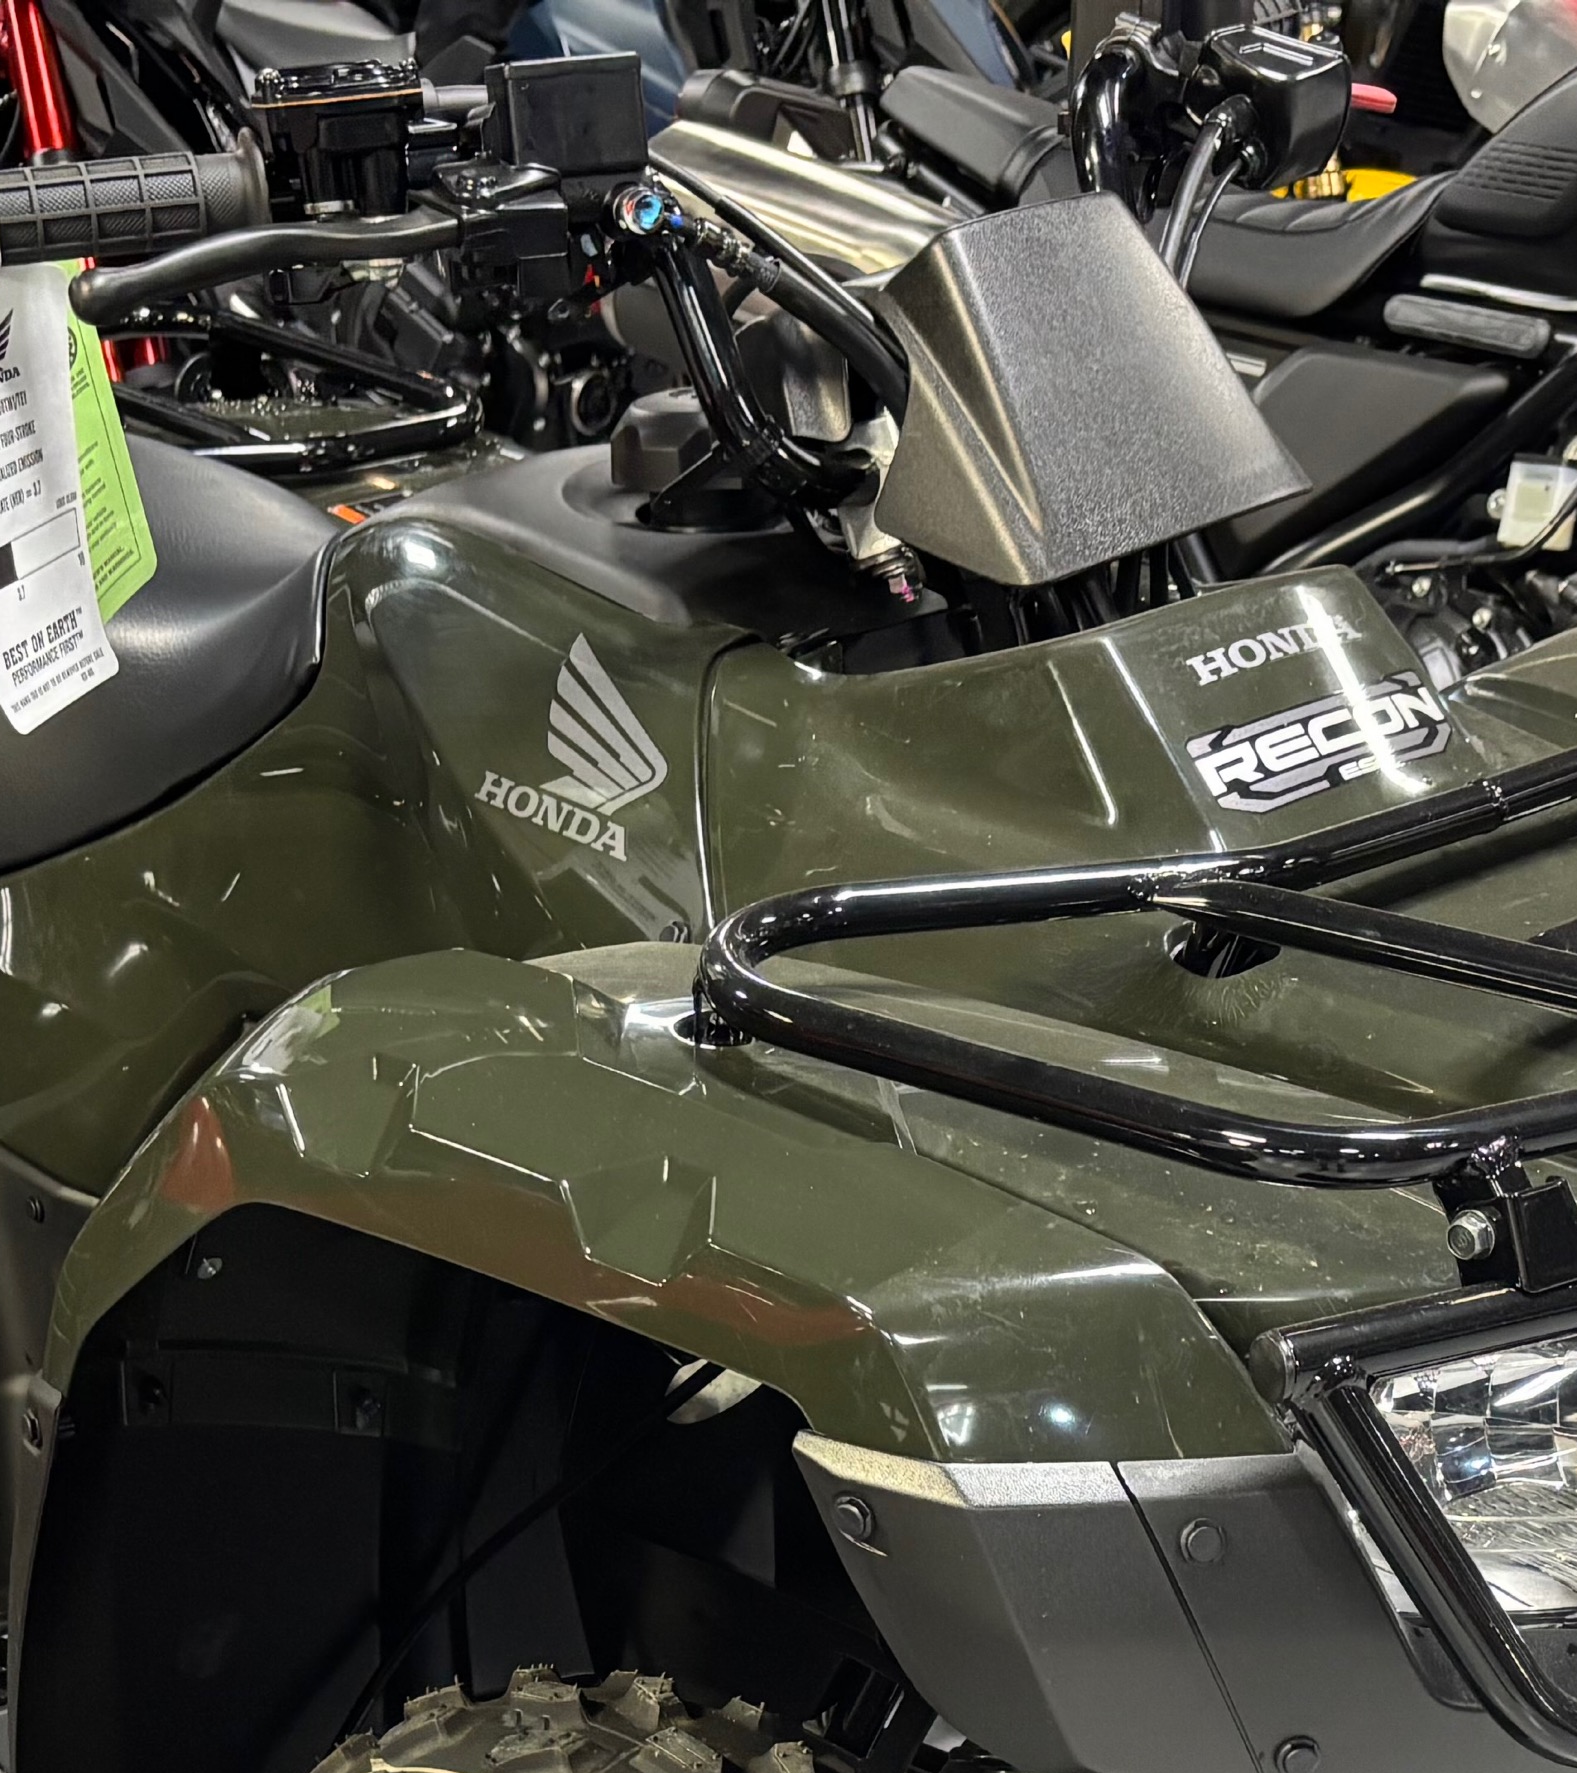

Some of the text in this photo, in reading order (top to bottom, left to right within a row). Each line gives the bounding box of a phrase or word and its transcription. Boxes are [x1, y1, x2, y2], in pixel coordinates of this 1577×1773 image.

[18, 448, 43, 472] EMISSION
[2, 640, 29, 670] BEST
[31, 630, 44, 653] ON
[12, 646, 60, 687] PERFORMANCE
[1195, 686, 1445, 797] RECON
[474, 770, 626, 861] HONDA
